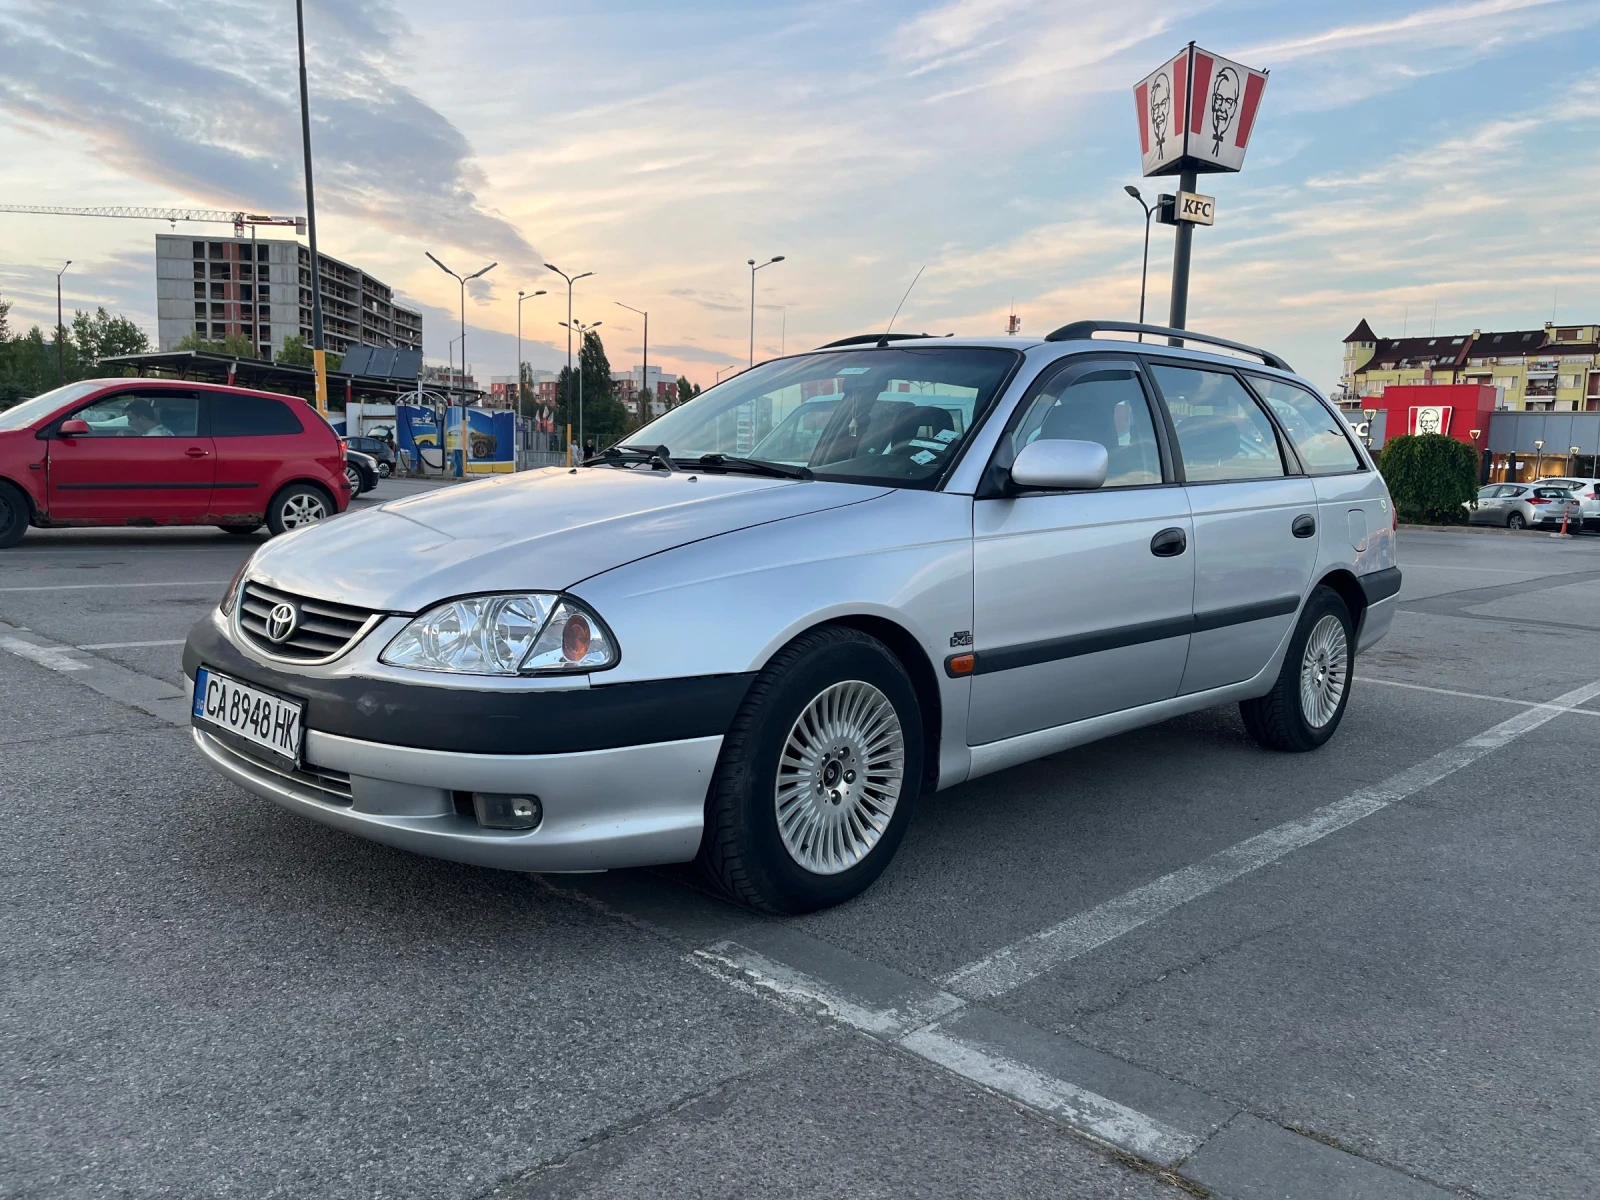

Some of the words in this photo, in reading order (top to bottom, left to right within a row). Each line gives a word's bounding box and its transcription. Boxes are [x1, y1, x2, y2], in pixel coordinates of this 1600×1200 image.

[1182, 198, 1212, 217] KFC
[206, 679, 226, 722] CA
[229, 689, 272, 739] 8948
[272, 704, 298, 752] HK
